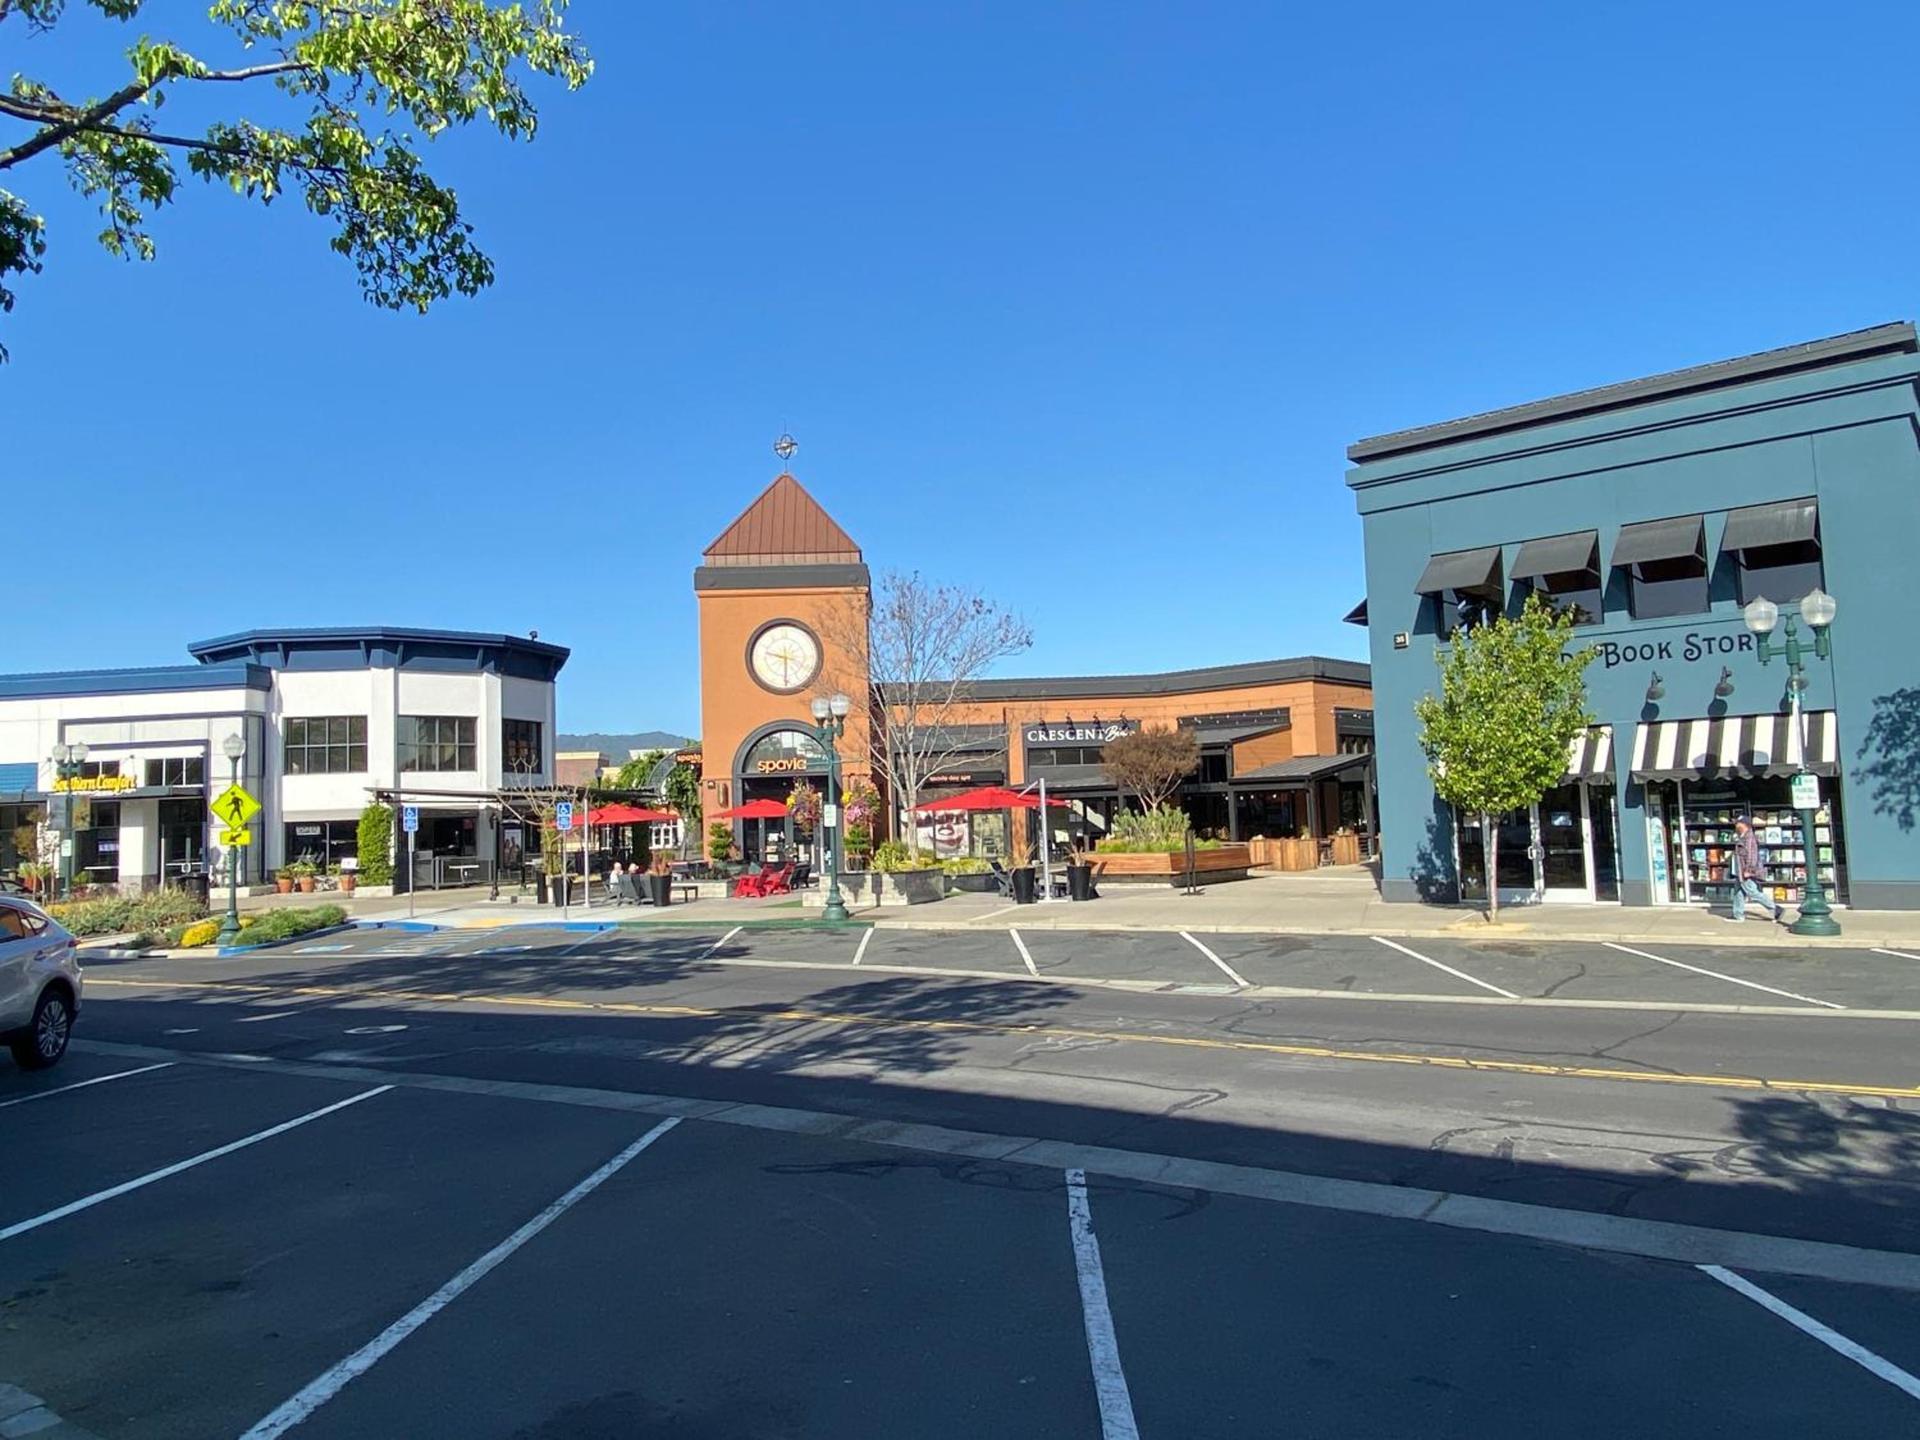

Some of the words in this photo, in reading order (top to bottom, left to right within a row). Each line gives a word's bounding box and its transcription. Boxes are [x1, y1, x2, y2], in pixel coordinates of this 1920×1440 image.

[1596, 641, 1673, 669] BOOK
[1683, 633, 1754, 662] STOR
[1027, 728, 1104, 742] CRESCENT
[757, 757, 808, 774] spavia
[97, 774, 136, 793] Comfort
